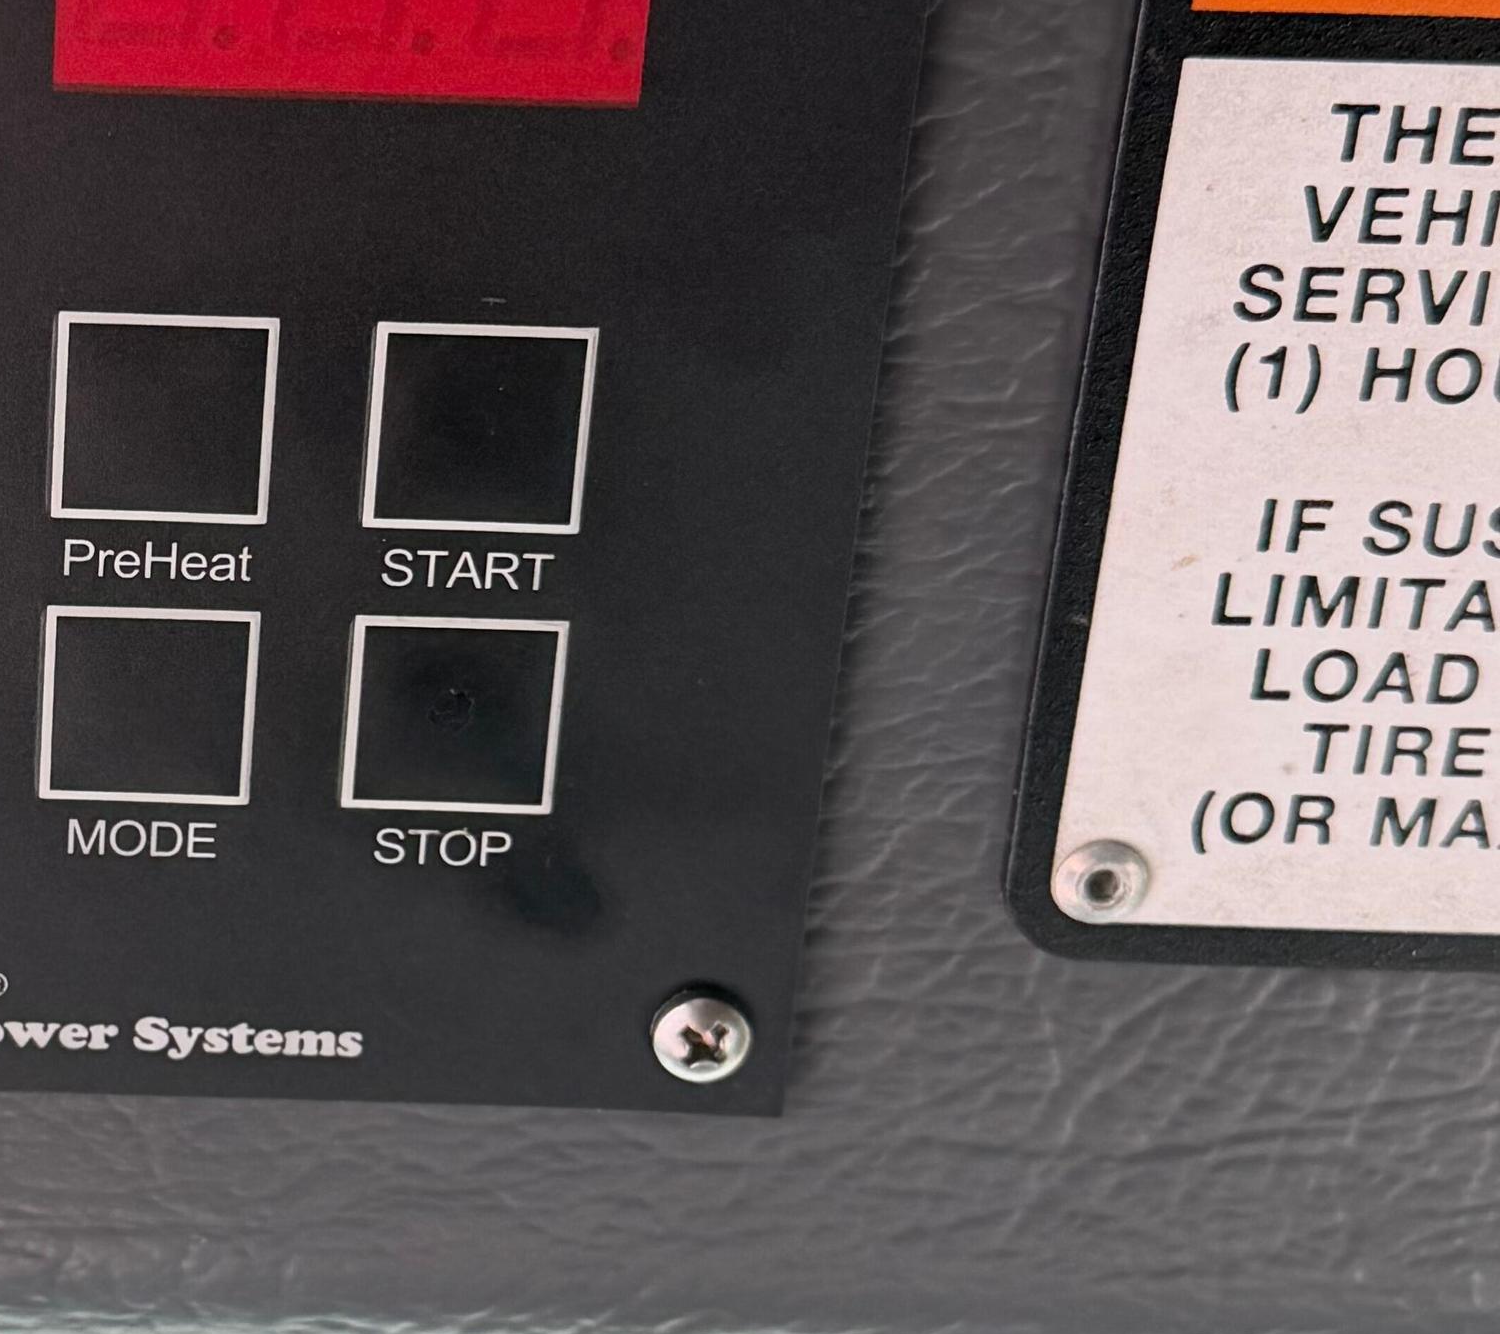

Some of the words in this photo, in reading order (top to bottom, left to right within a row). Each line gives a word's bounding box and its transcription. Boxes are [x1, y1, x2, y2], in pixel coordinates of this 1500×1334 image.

[1331, 103, 1500, 166] THE
[1233, 263, 1492, 327] SERVI
[1225, 342, 1322, 414] (1)
[1359, 347, 1500, 405] HO
[1257, 498, 1334, 553] IF
[62, 538, 253, 583] PreHeat
[381, 548, 556, 591] START
[1211, 572, 1496, 632] LIMITA
[1250, 648, 1480, 705] LOAD
[1304, 723, 1492, 778] TIRE
[67, 818, 218, 859] MODE
[373, 827, 513, 868] STOP
[1191, 790, 1336, 855] (OR
[1370, 796, 1500, 850] MA
[132, 1016, 363, 1061] Systems
